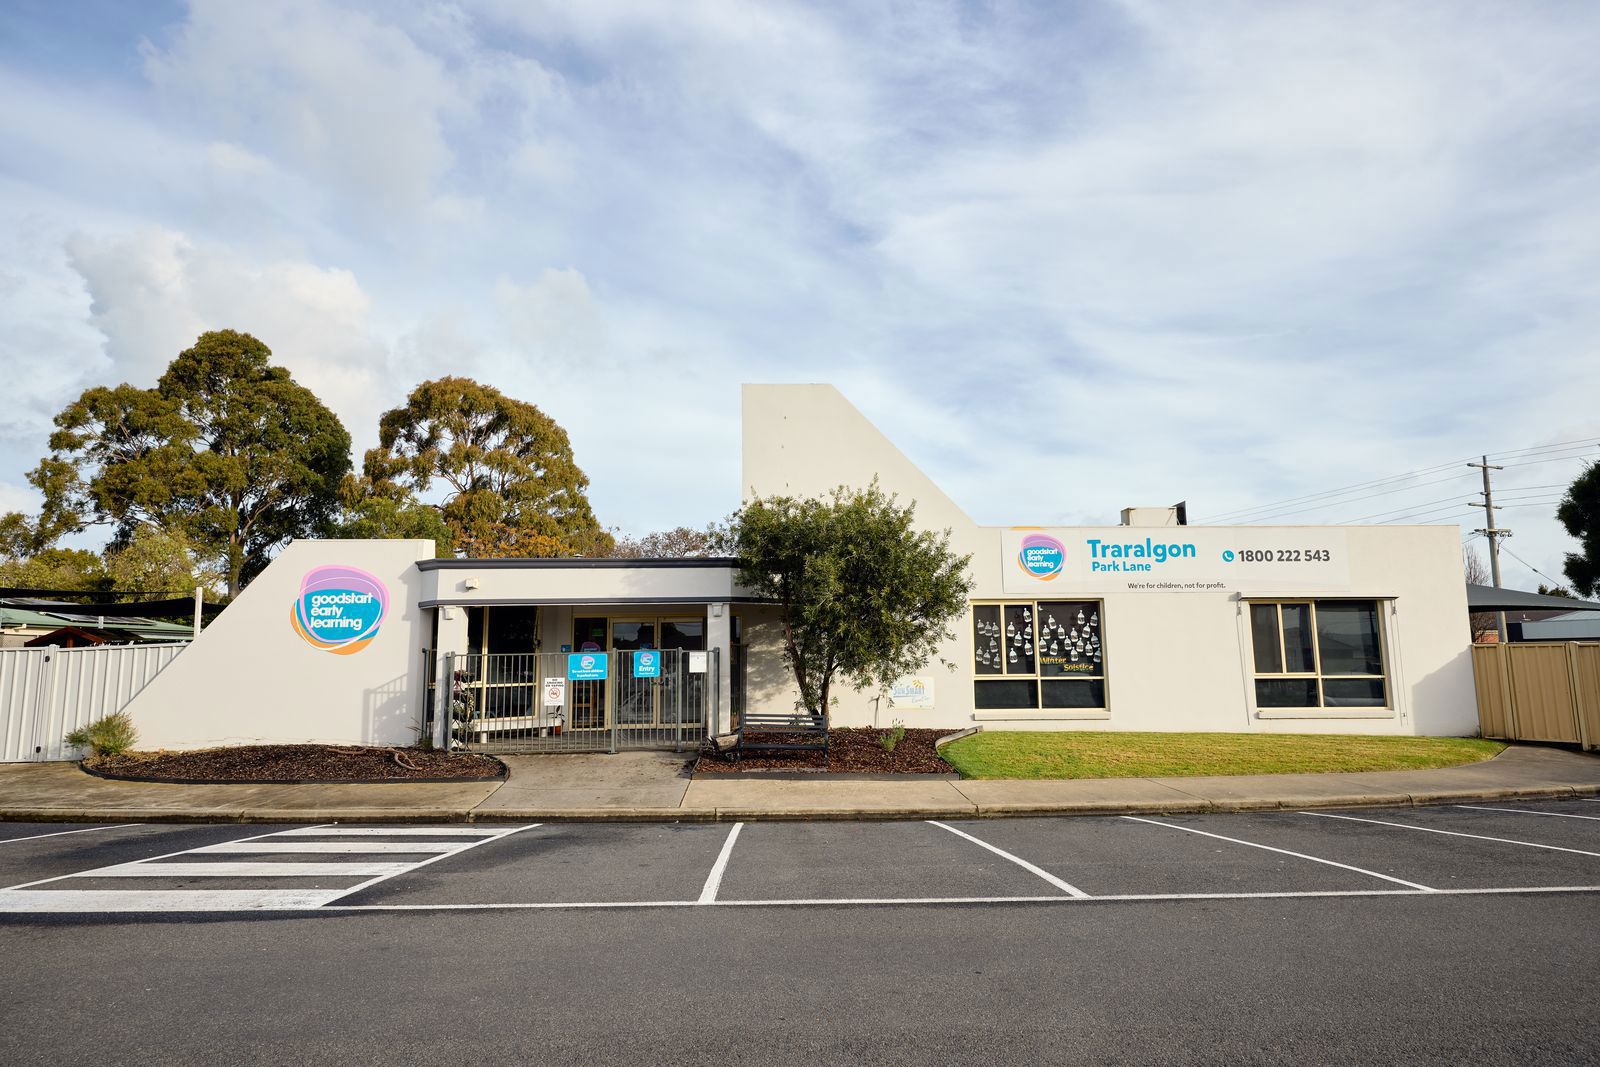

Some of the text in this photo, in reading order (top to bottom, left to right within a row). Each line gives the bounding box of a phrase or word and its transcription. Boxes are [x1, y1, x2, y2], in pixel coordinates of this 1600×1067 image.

[1027, 548, 1058, 556] goodstart
[1086, 537, 1196, 563] Traralgon
[1238, 549, 1331, 562] 1800 222 543
[1027, 561, 1054, 569] learning
[1092, 560, 1152, 572] Park Lane
[1156, 582, 1184, 590] children,
[1206, 582, 1227, 590] profit.
[311, 592, 373, 607] goodstart
[310, 605, 344, 619] early
[310, 616, 362, 631] learning
[1063, 664, 1094, 672] Solstice
